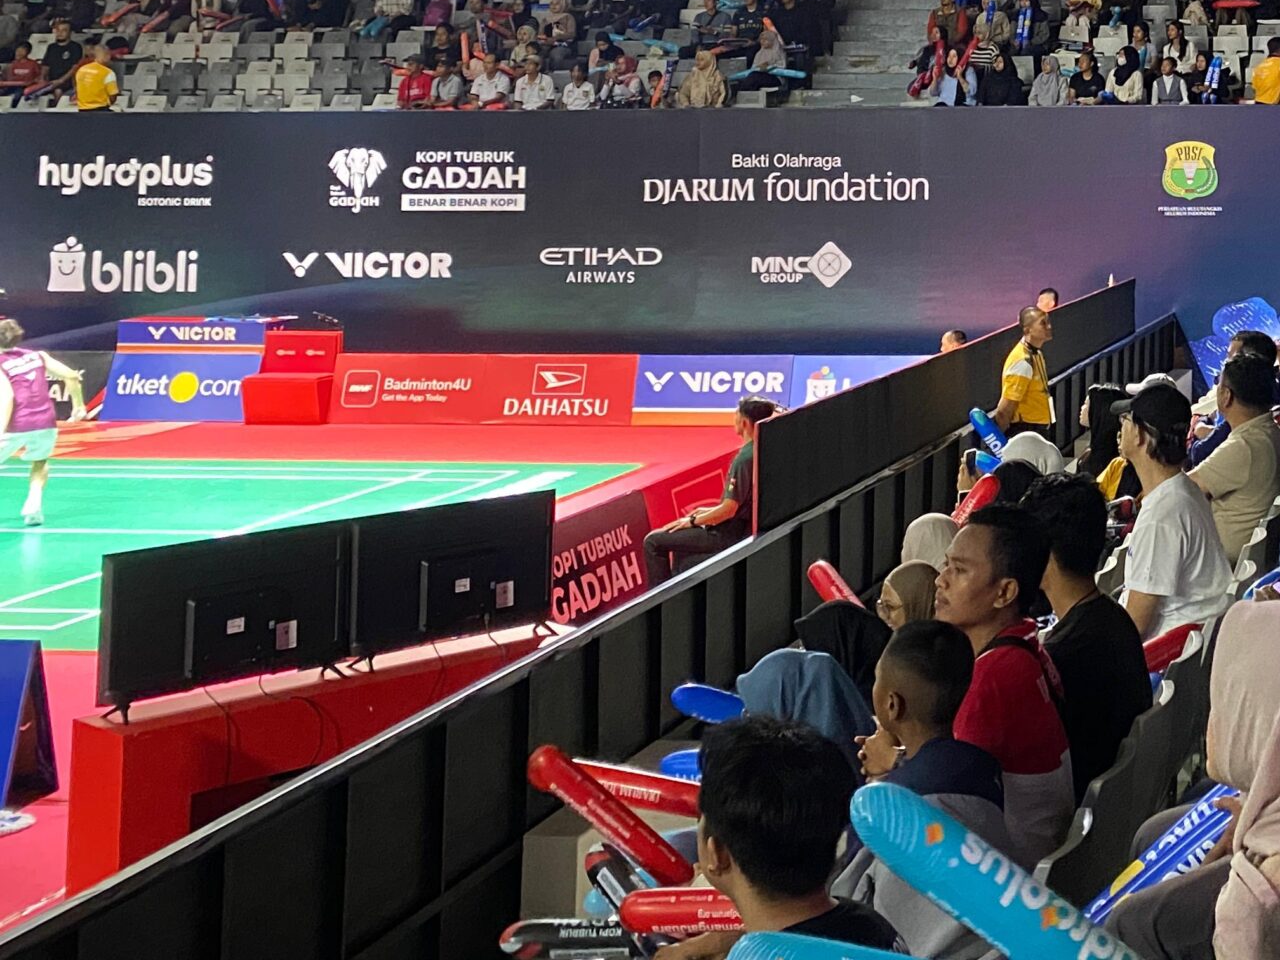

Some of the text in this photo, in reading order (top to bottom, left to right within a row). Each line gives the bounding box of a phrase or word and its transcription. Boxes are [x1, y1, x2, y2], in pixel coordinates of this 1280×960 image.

[416, 151, 515, 163] KOPI TUBRUK
[732, 152, 842, 171] Bakti Olahraga
[1176, 146, 1203, 161] PBSI
[38, 155, 211, 195] hydroplus
[402, 166, 526, 189] GADJAH
[643, 171, 930, 204] DJARUM foundation
[184, 197, 212, 206] DRINK
[408, 198, 518, 207] BENAR BENAR KOPI
[324, 252, 452, 279] VICTOR
[539, 247, 663, 267] ETIHAD
[751, 255, 812, 275] MNC
[92, 250, 198, 292] blibli
[566, 270, 636, 284] AIRWAYS
[760, 273, 804, 284] GROUP
[171, 326, 236, 341] VICTOR
[383, 377, 472, 391] Badminton4U
[680, 370, 783, 393] VICTOR
[382, 393, 395, 401] Get
[408, 393, 424, 403] App
[425, 393, 448, 403] Today
[503, 398, 609, 416] DAIHATSU
[553, 523, 633, 581] OPI TUBRUK
[552, 551, 643, 624] GADJAH
[558, 927, 623, 939] KOPI TUBRUK
